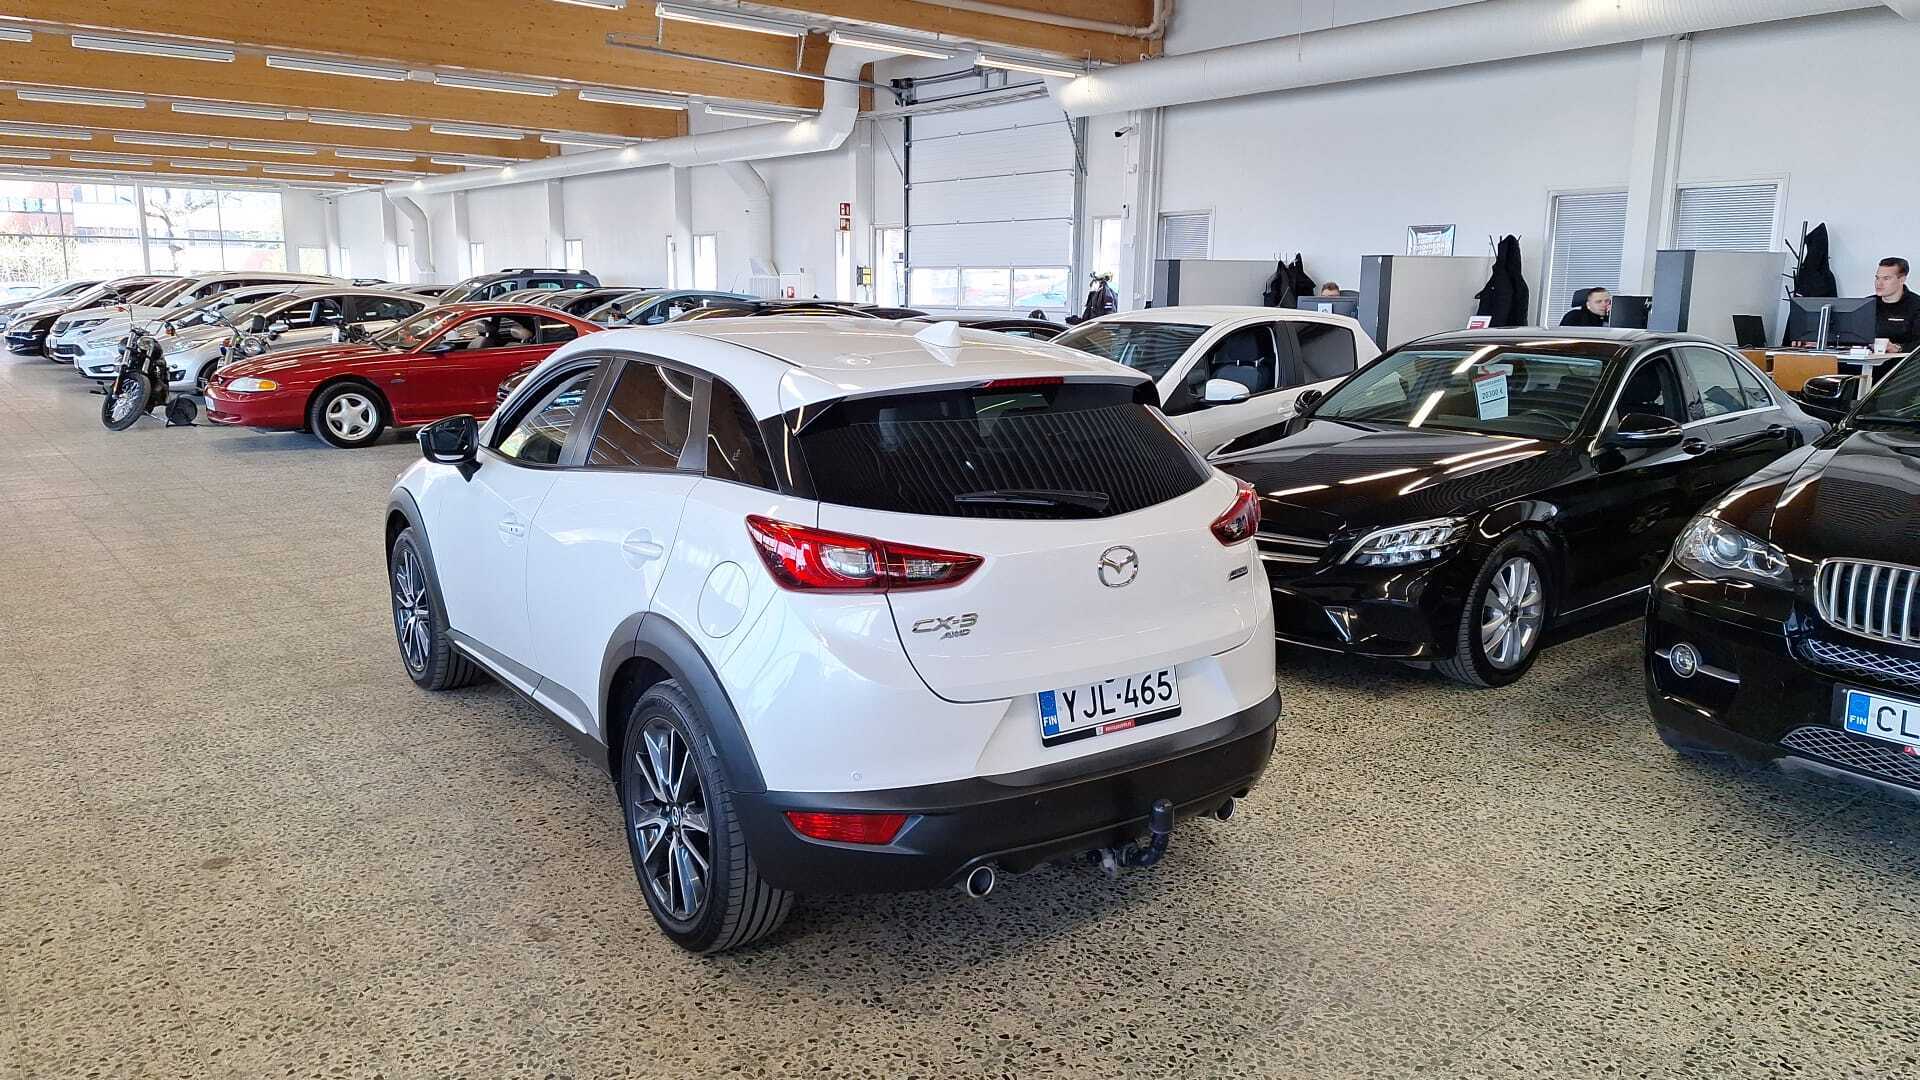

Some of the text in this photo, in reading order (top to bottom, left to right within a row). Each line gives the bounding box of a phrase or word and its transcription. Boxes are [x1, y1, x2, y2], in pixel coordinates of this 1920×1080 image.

[912, 613, 978, 633] CX-3
[940, 628, 971, 640] AWD
[1043, 715, 1058, 726] FIN
[1848, 715, 1868, 726] FIN
